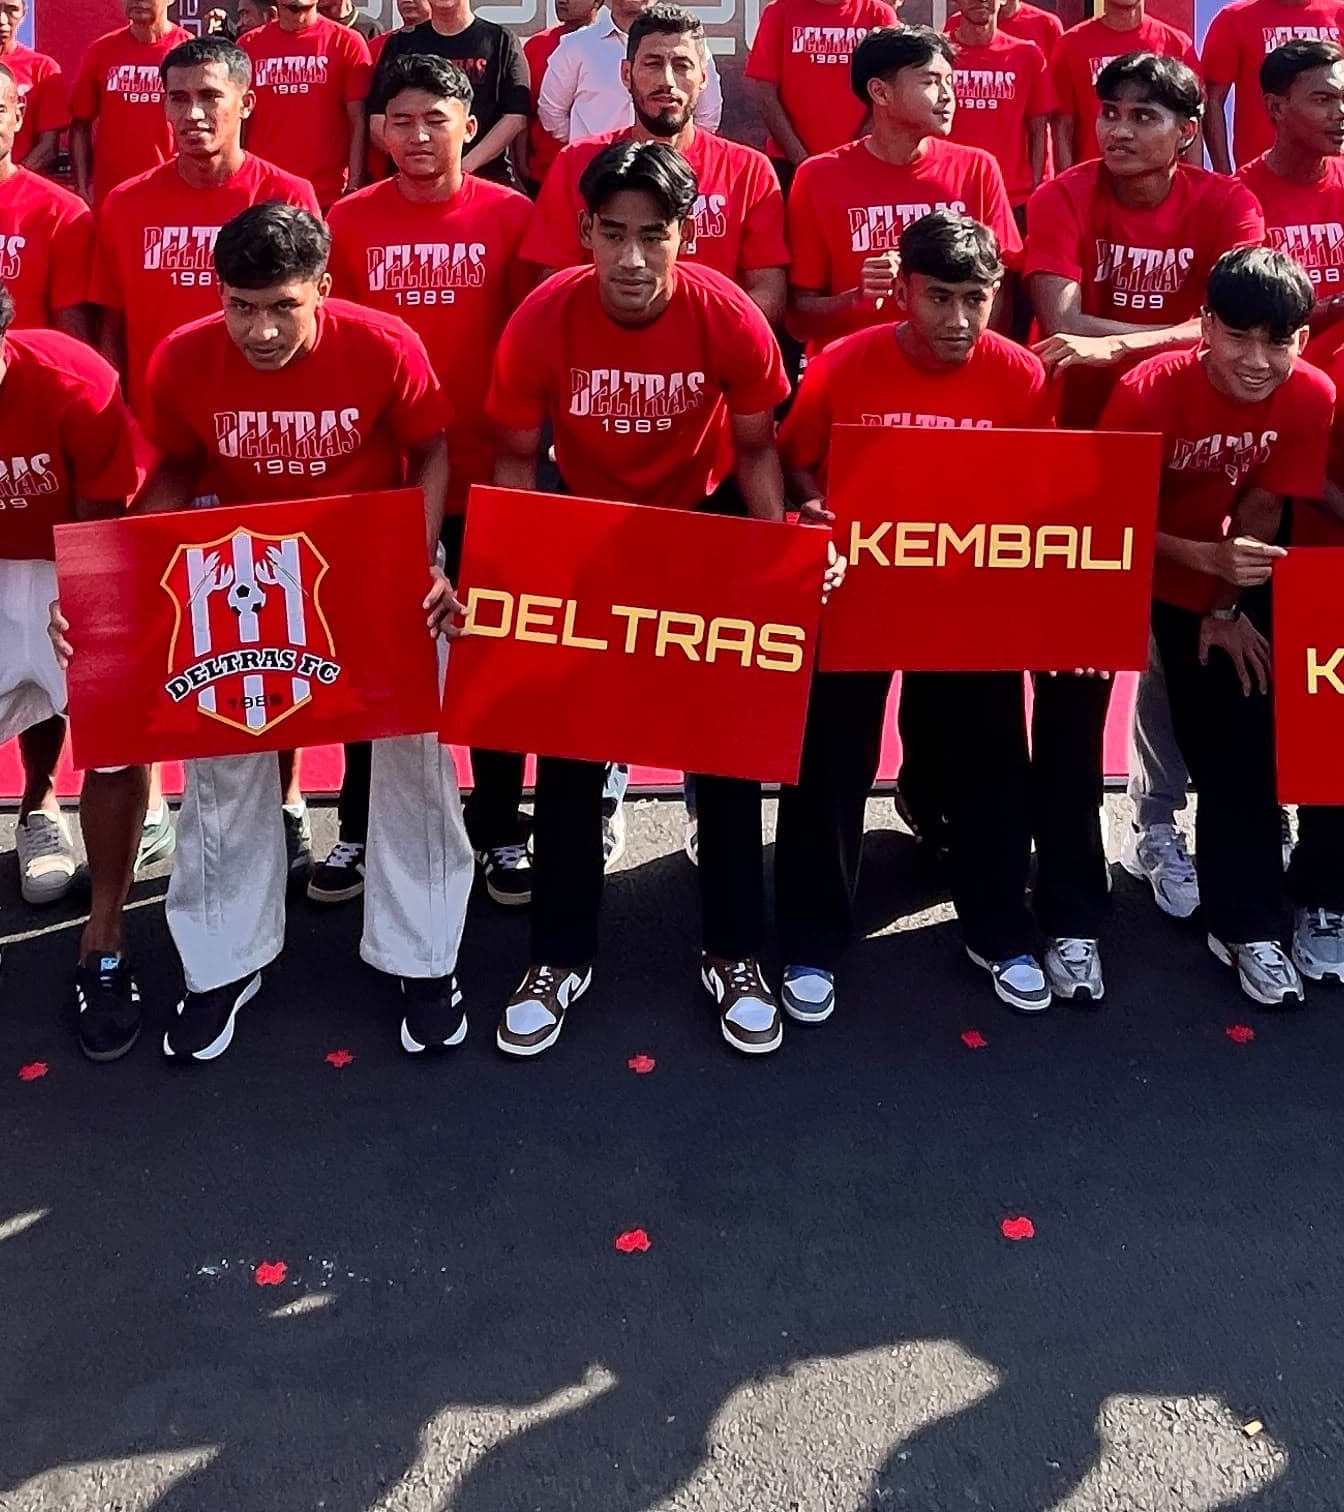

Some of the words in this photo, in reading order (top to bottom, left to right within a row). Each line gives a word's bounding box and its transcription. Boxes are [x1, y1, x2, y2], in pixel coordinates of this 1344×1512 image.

[953, 70, 1016, 100] ELTRAS
[170, 271, 213, 286] 198
[367, 244, 486, 291] DELTRAS
[1094, 239, 1194, 293] DLTRAS
[395, 290, 455, 305] 1989
[1113, 292, 1164, 309] 989
[569, 367, 707, 418] DELTRAS
[214, 407, 362, 460] DELTRAS
[601, 418, 673, 434] 1989
[253, 460, 327, 477] 1989
[849, 520, 1134, 571] KEMBALI
[463, 585, 805, 673] DELTRAS
[165, 648, 296, 703] DELTRAS
[298, 652, 341, 685] FC
